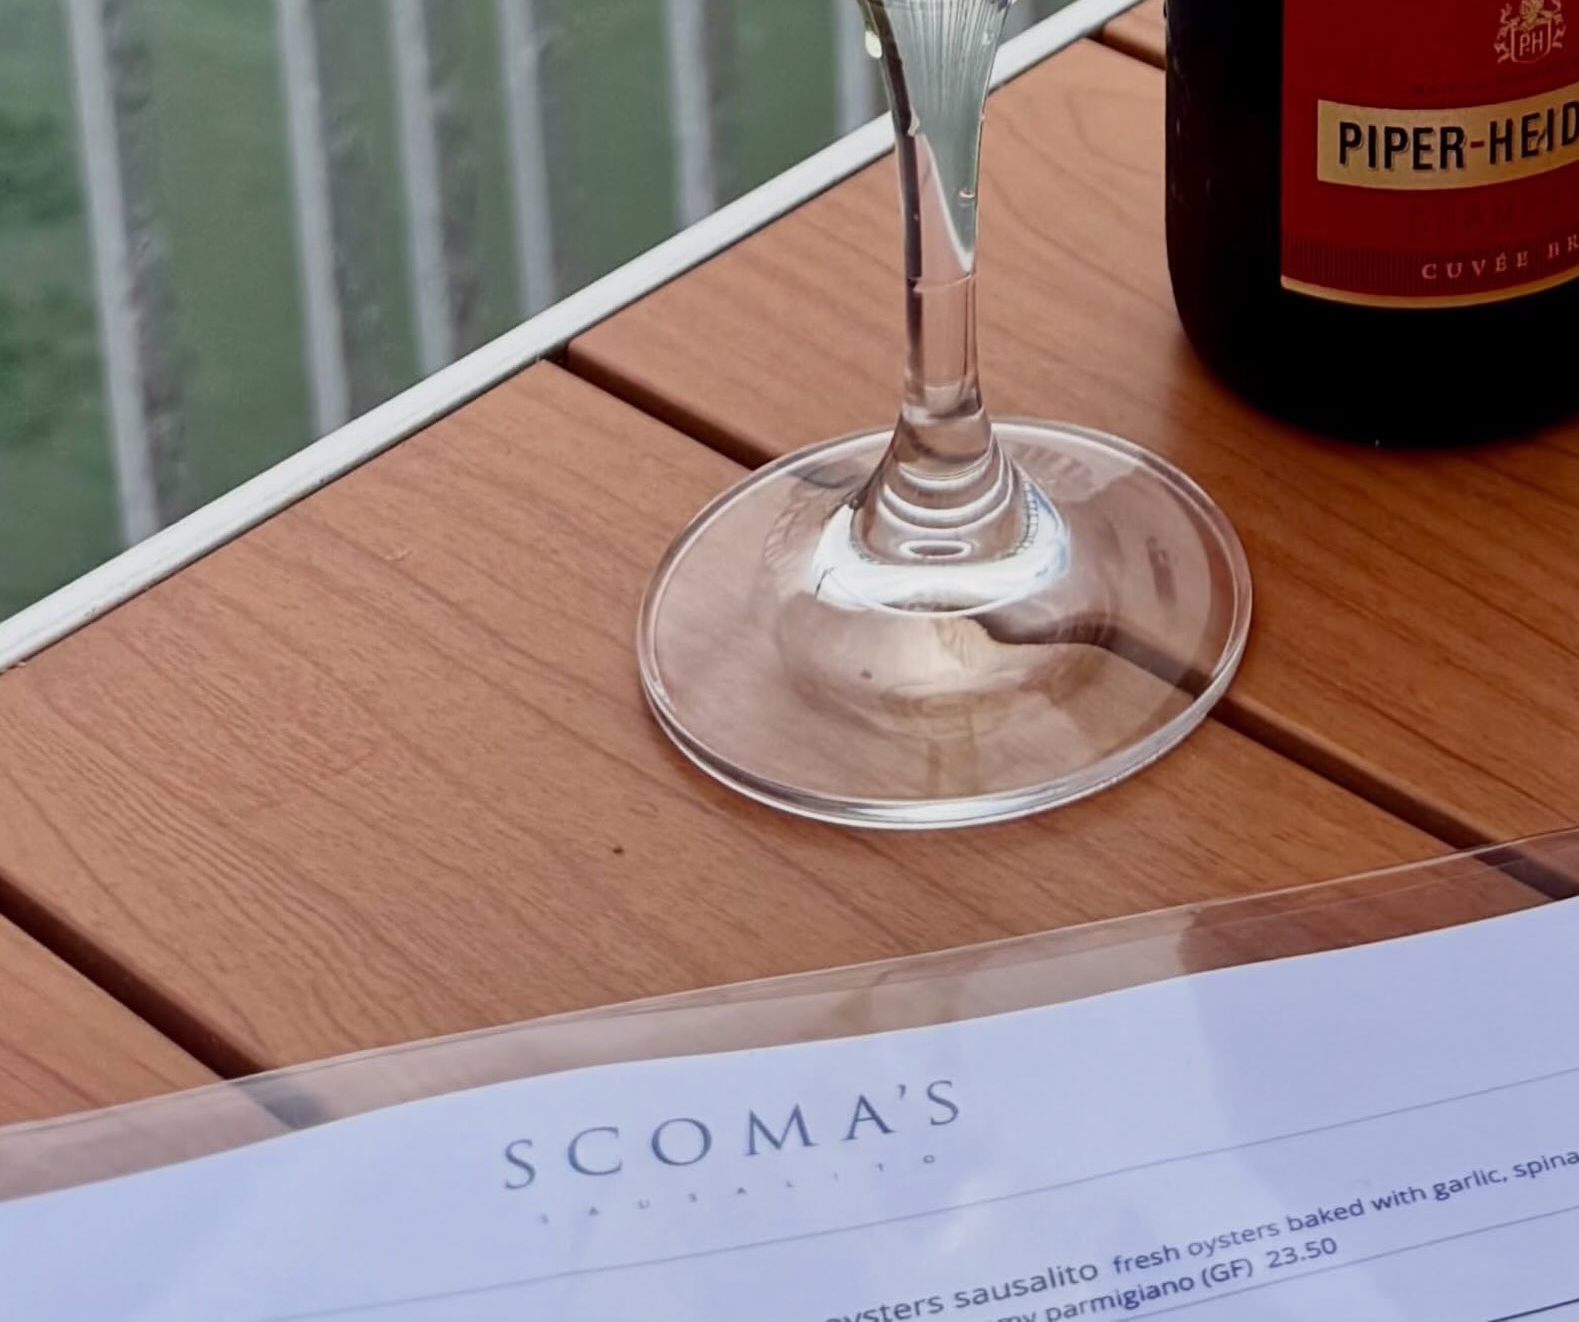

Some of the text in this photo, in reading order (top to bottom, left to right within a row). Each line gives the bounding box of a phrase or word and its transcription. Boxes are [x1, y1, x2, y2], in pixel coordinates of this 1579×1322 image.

[1421, 251, 1530, 282] CUVÉE
[504, 1080, 960, 1190] SCOMA'S
[954, 1262, 1099, 1310] sausalito
[1113, 1244, 1181, 1276] fresh
[1188, 1220, 1280, 1257] oysters
[1287, 1197, 1365, 1233] baked
[1371, 1183, 1427, 1213] with
[1433, 1166, 1509, 1201] garlic,
[1045, 1236, 1338, 1322] parmigiano (GF) 23.50
